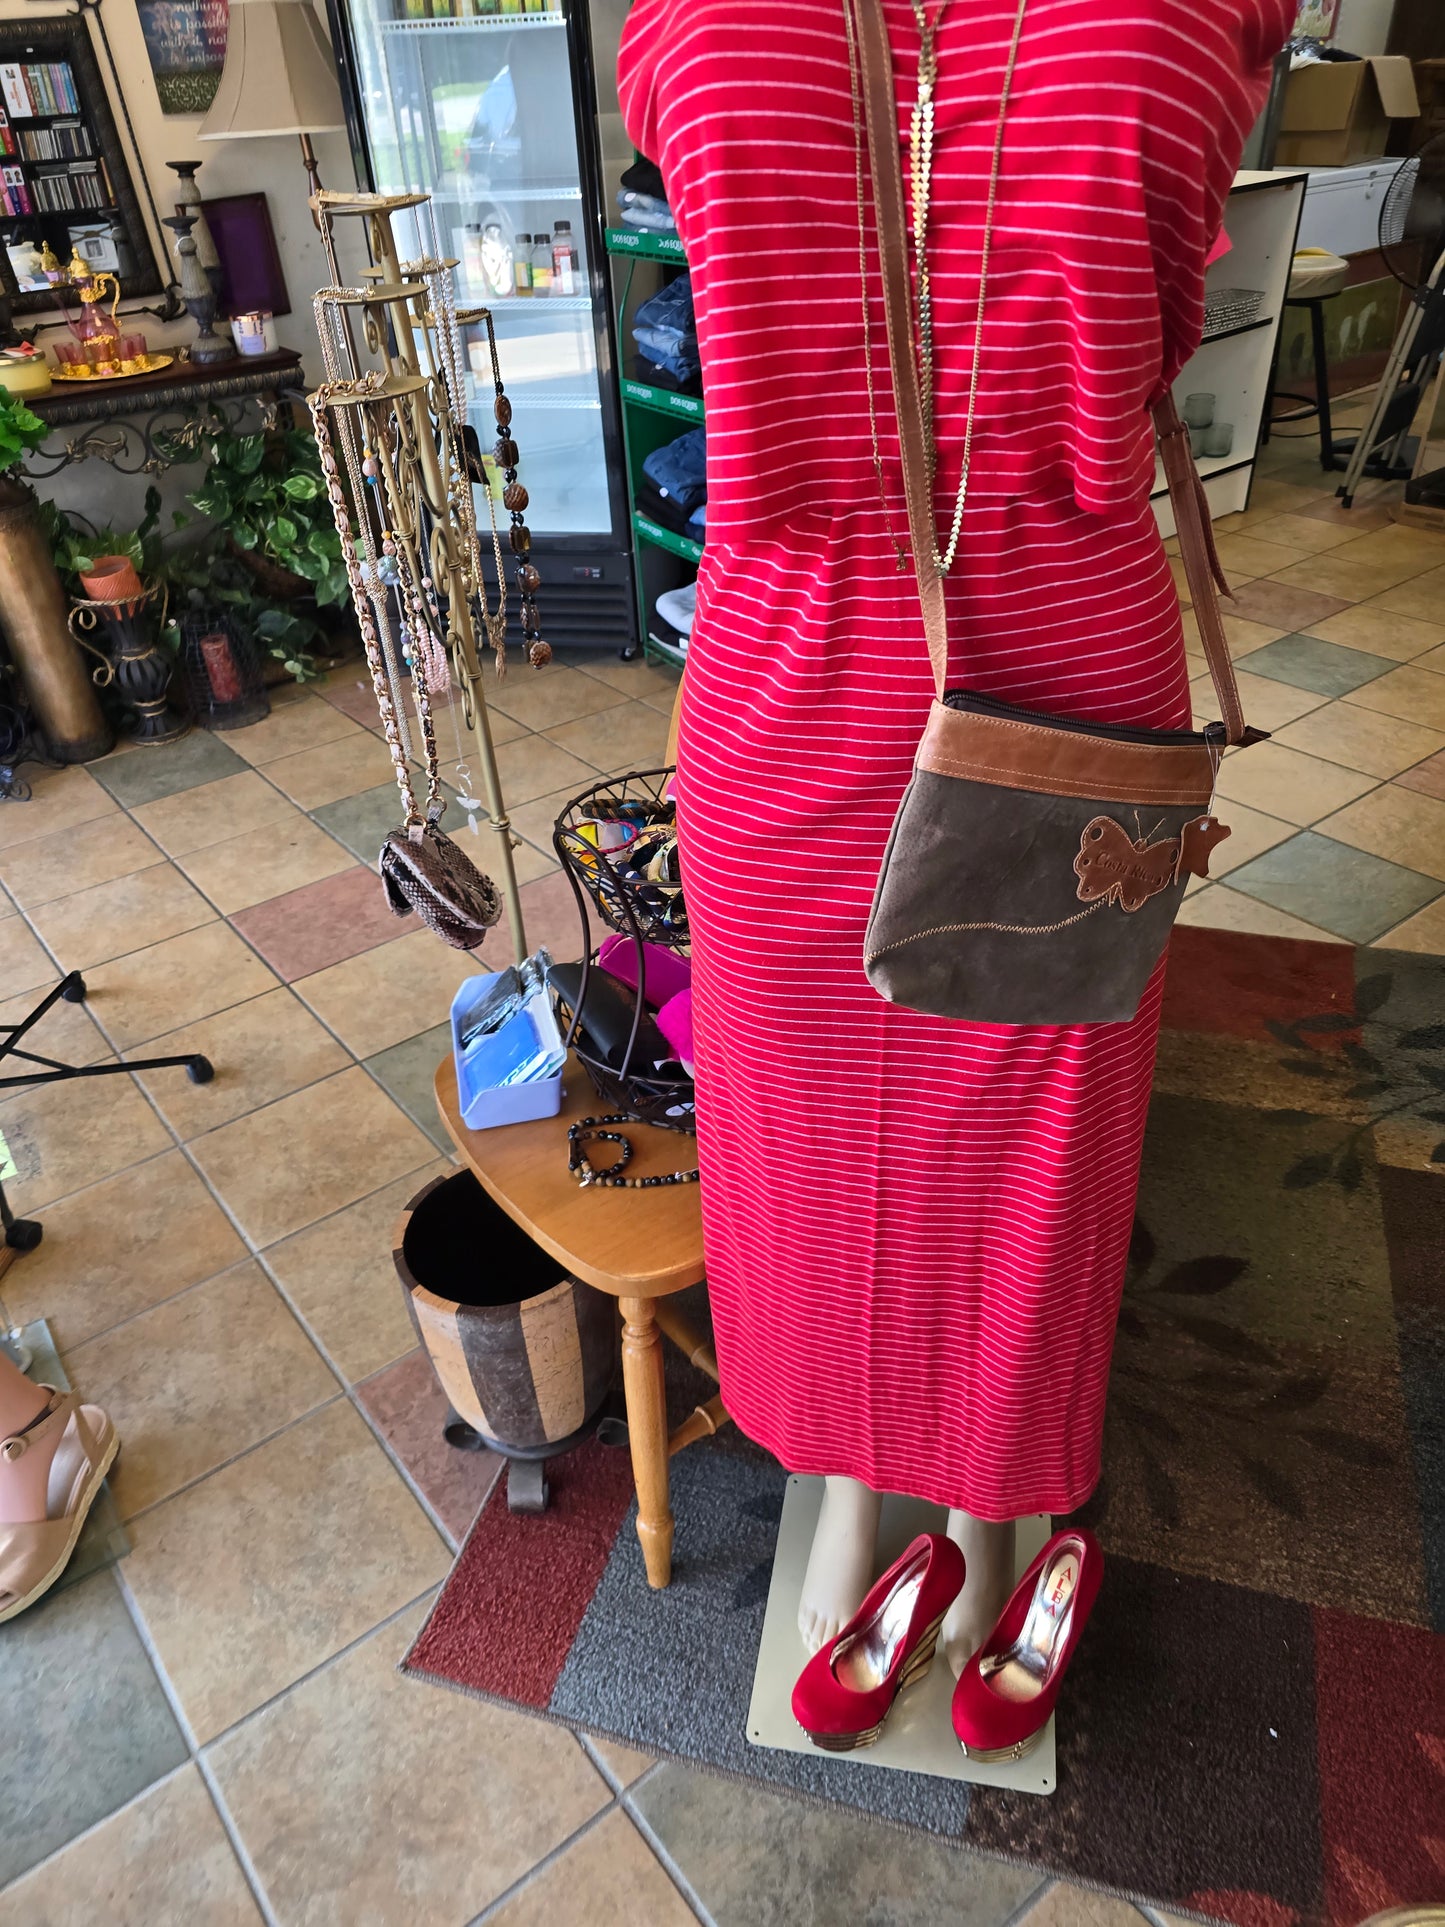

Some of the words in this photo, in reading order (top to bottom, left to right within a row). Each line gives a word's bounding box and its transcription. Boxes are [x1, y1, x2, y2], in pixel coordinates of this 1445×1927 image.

[186, 12, 229, 34] possibl
[623, 235, 640, 247] EQUIS
[681, 399, 699, 411] EQUIS
[1095, 851, 1129, 875] Costa
[1045, 1566, 1072, 1619] ALBA
